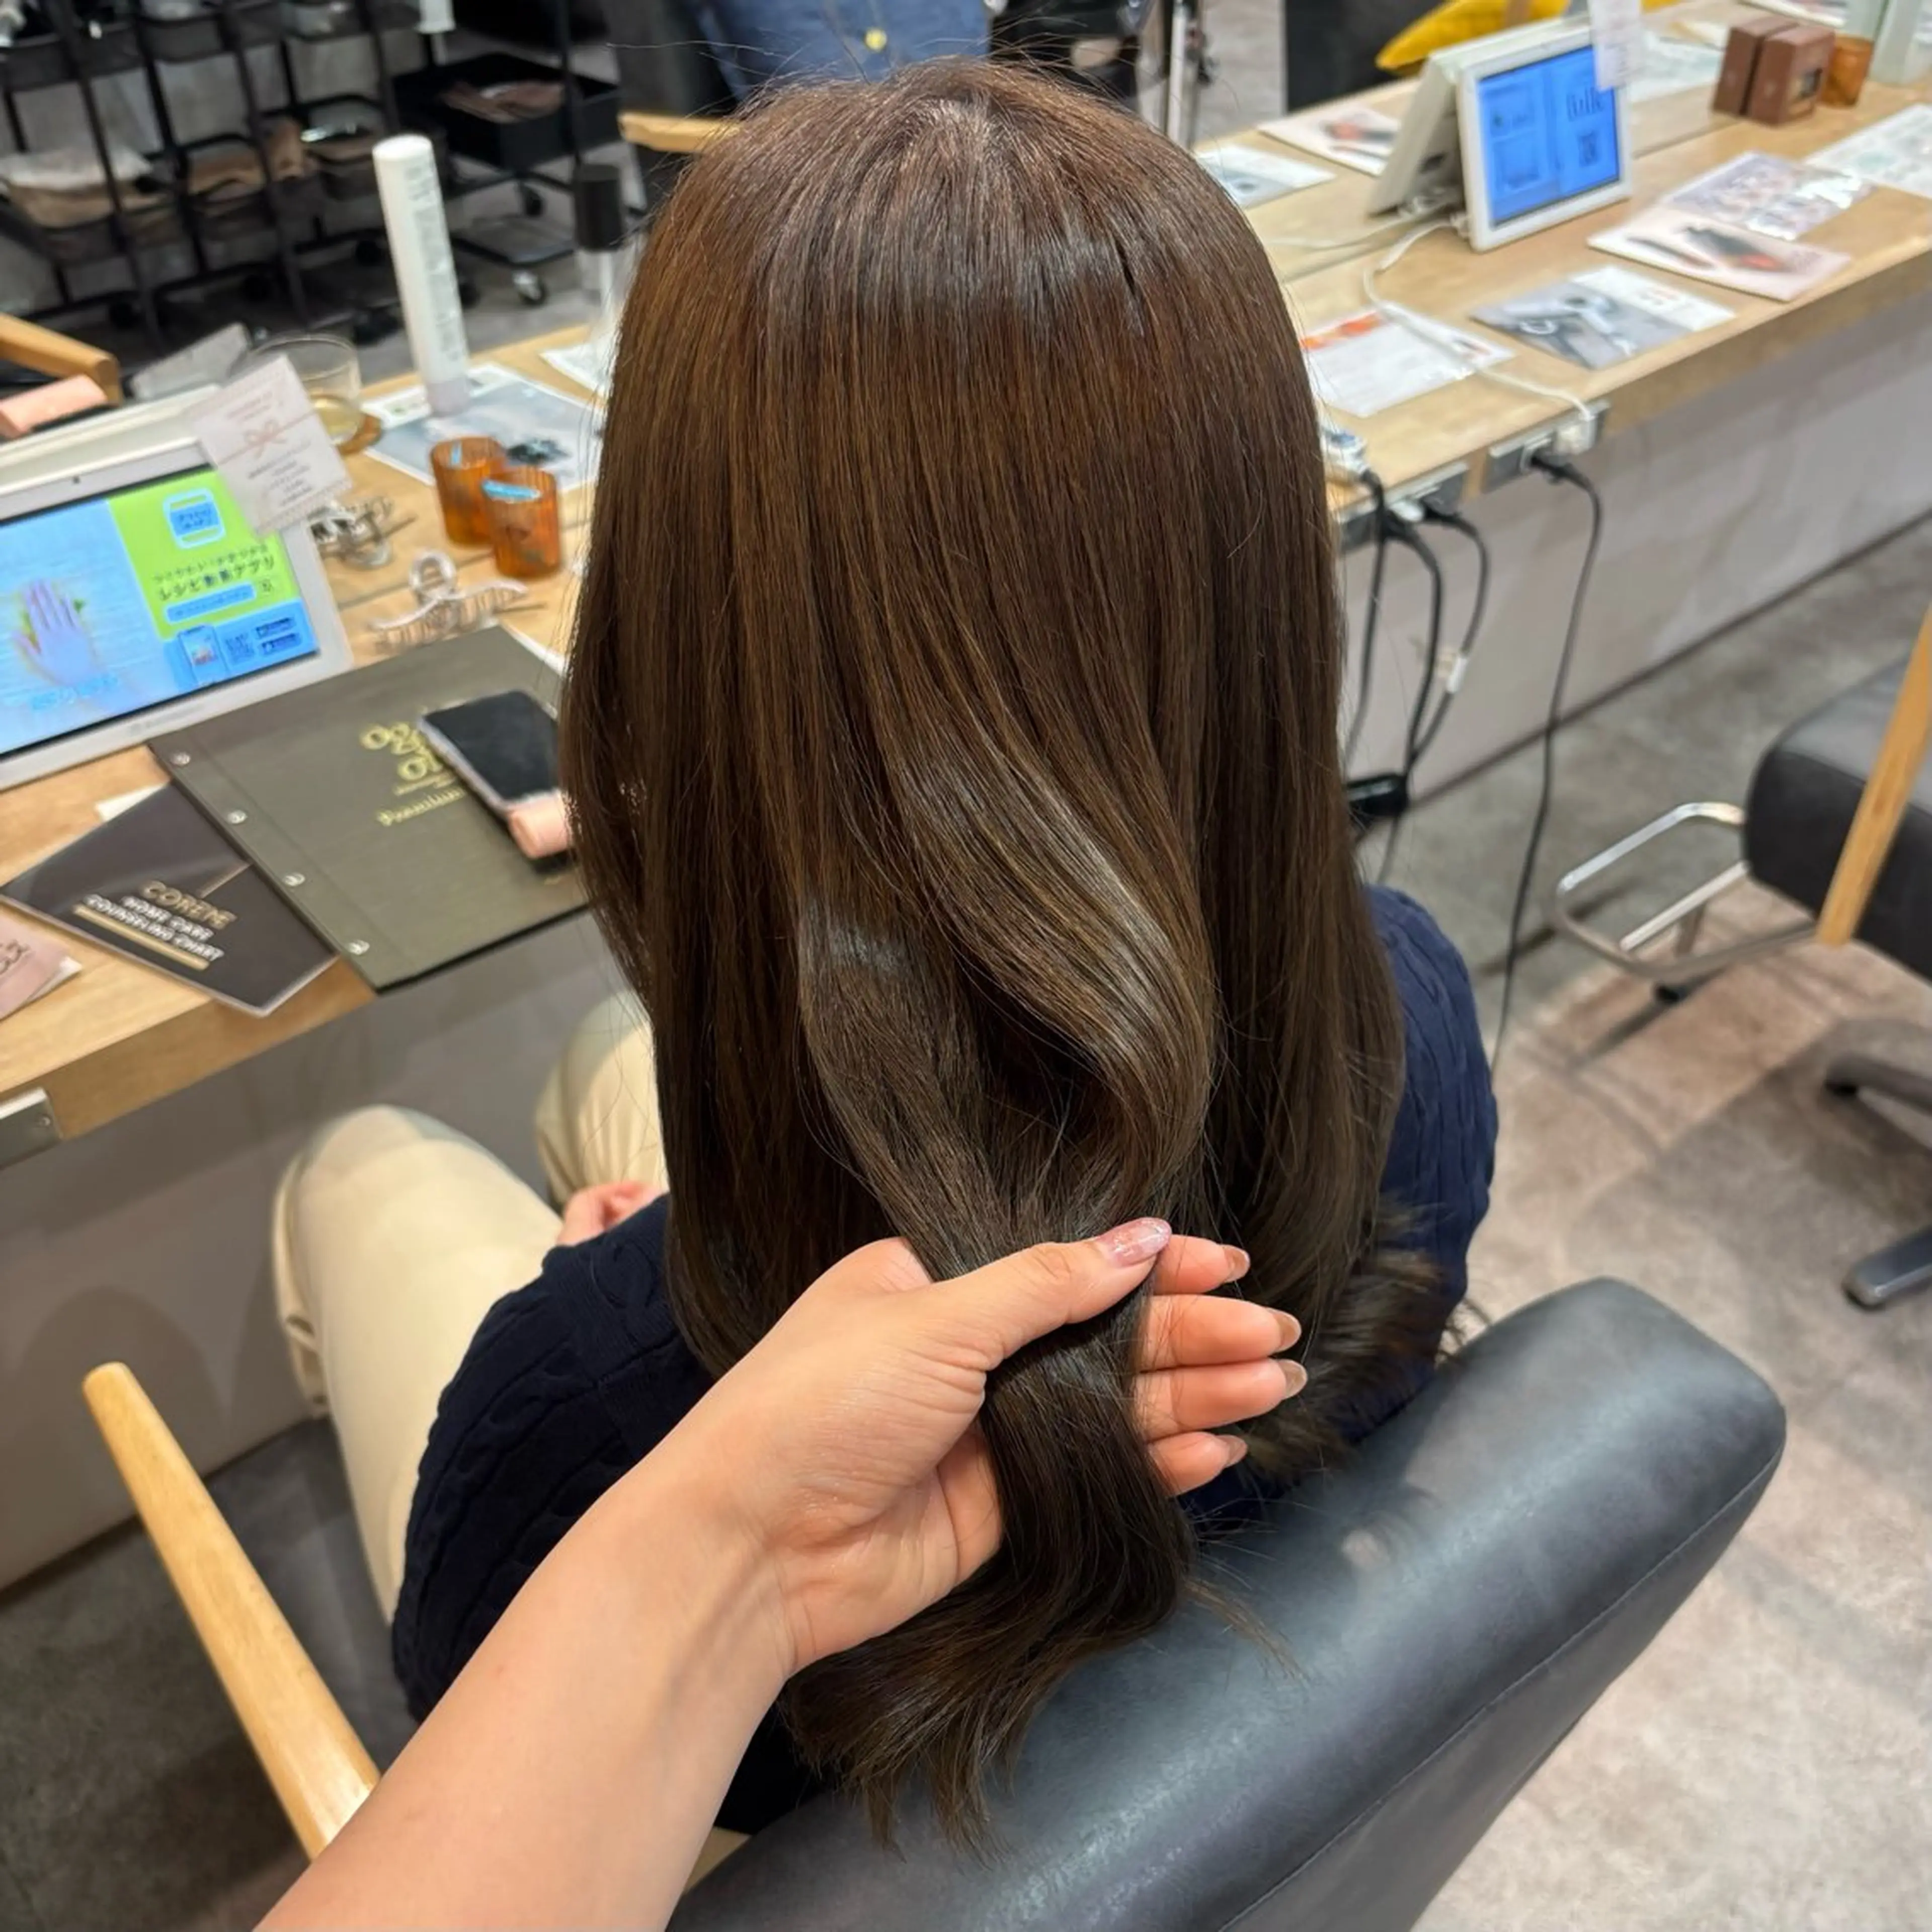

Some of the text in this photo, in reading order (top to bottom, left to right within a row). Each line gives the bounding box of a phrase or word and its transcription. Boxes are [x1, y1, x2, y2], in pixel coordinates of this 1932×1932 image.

[121, 896, 214, 942] HOME CARE
[173, 933, 225, 961] CHART
